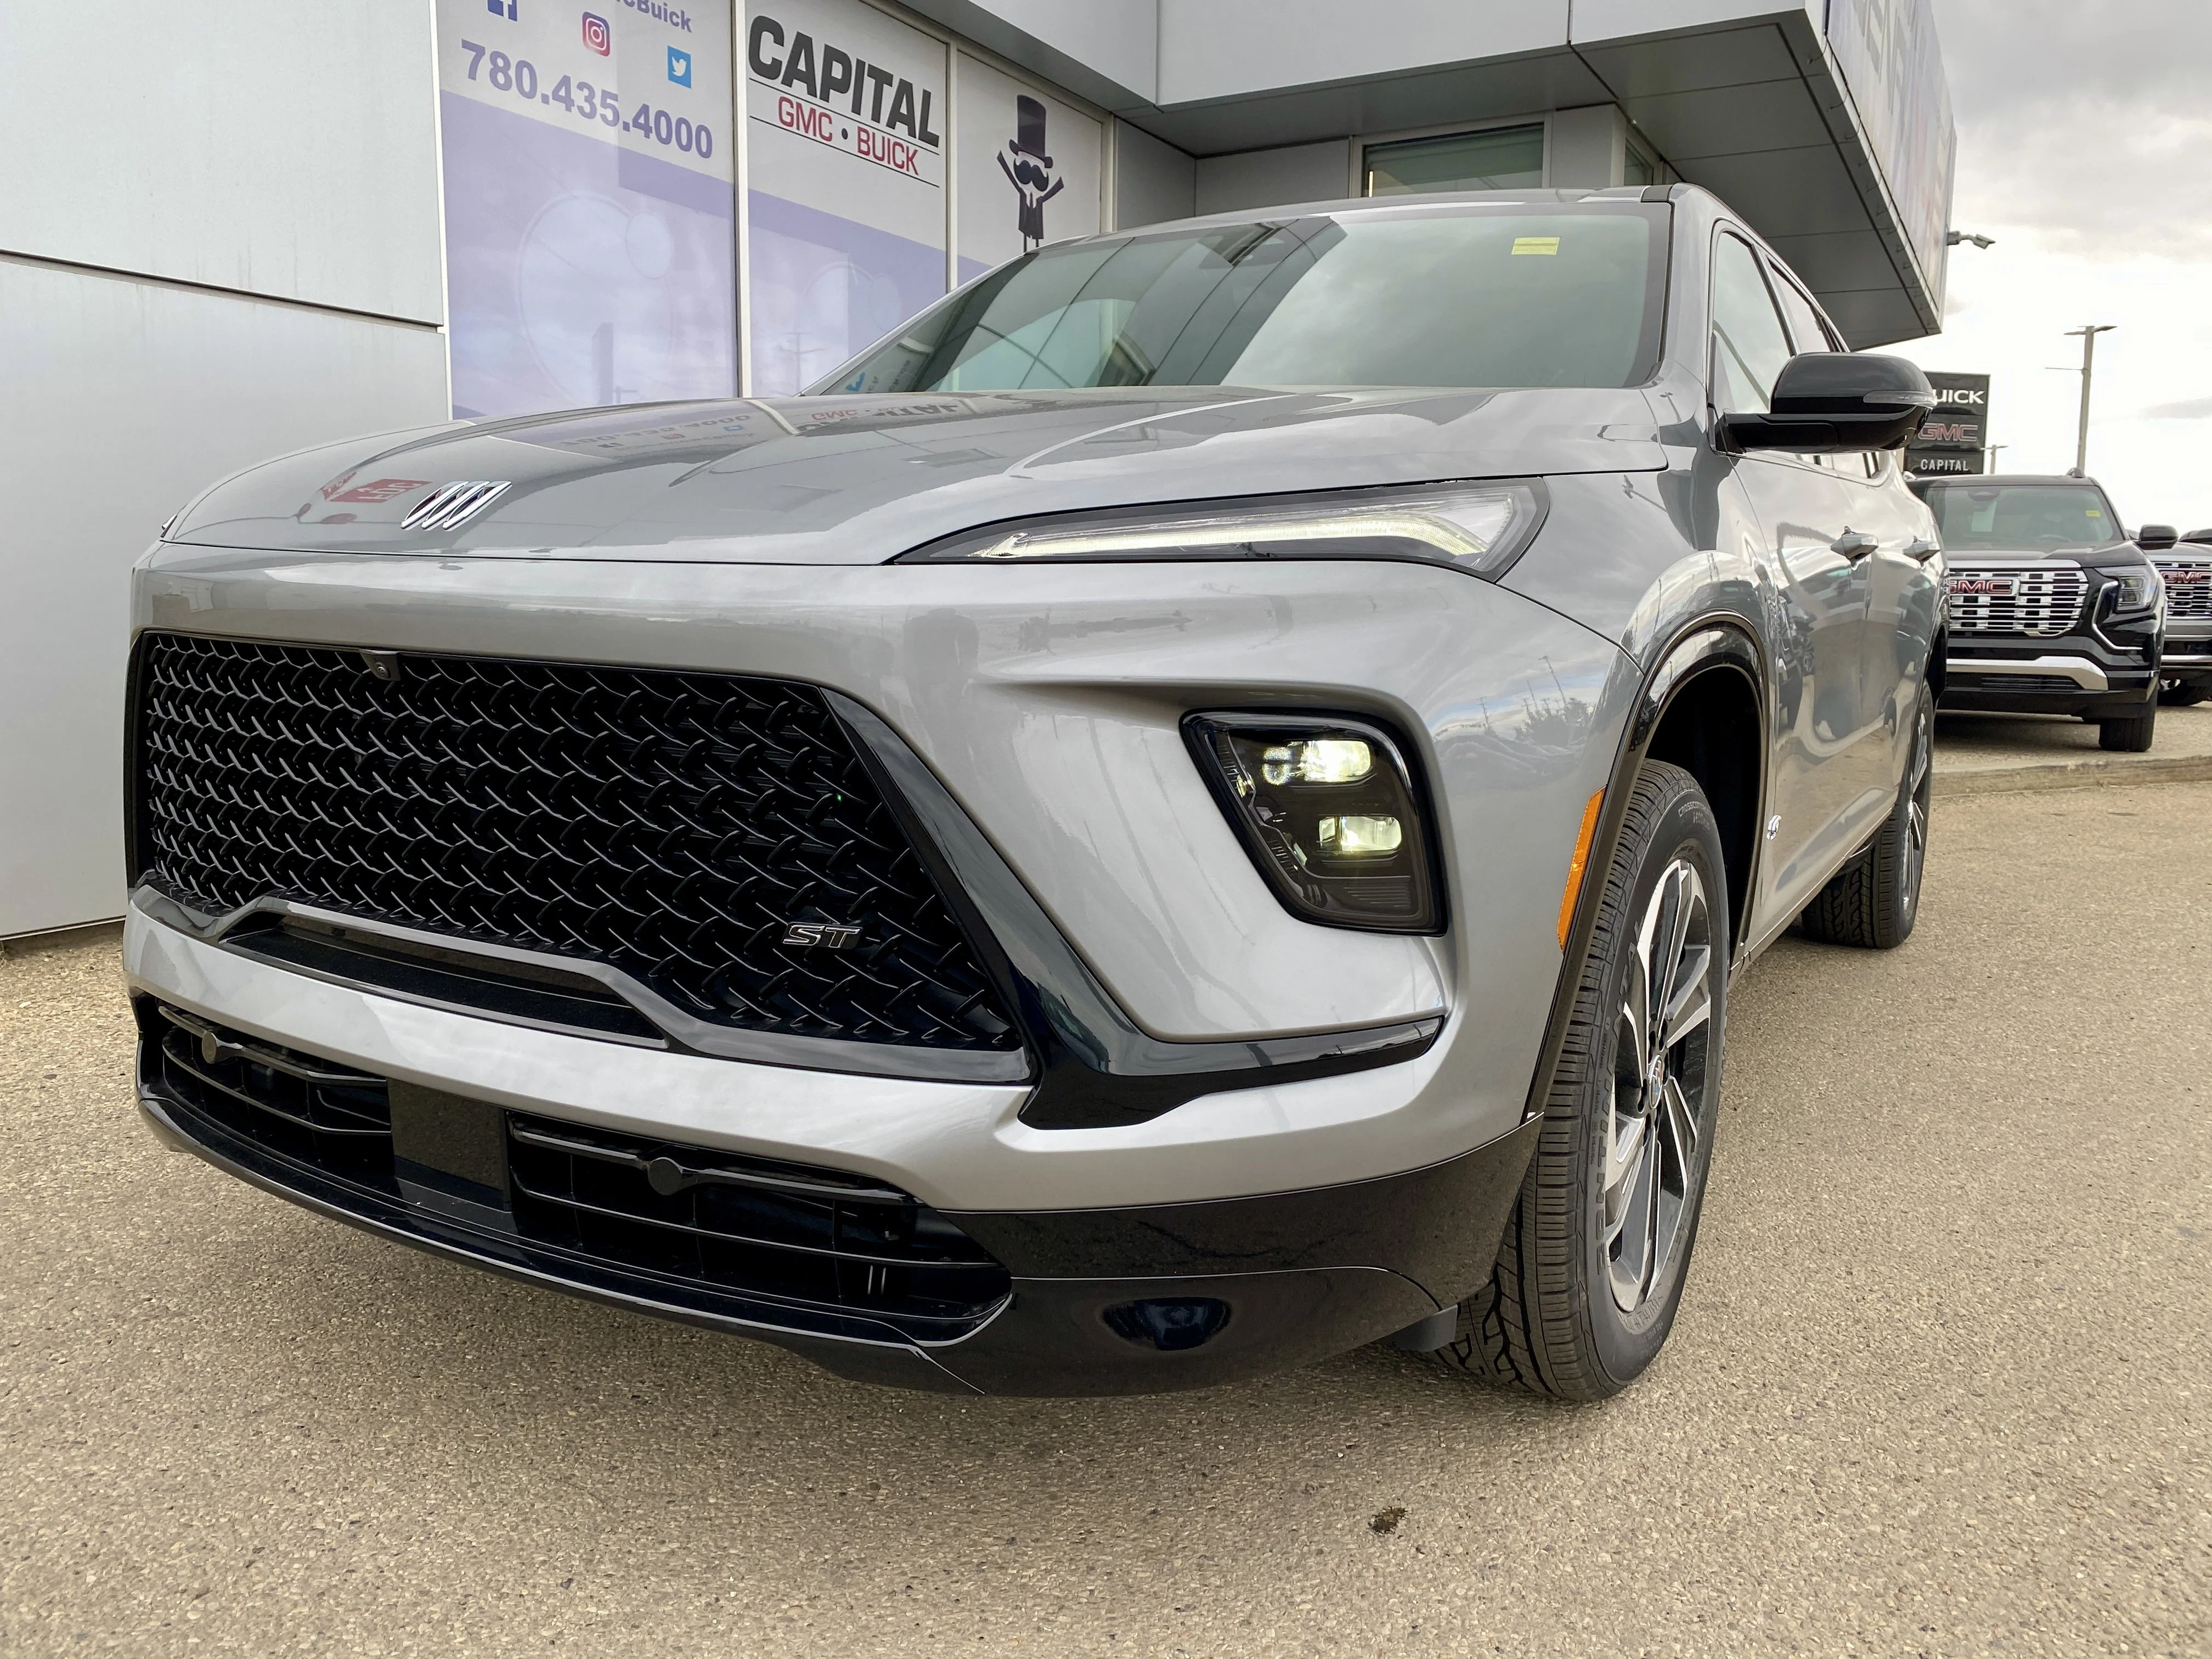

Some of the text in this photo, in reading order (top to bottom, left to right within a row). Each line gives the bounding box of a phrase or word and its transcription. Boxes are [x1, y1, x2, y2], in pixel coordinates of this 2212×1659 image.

[749, 15, 940, 148] CAPITAL
[461, 38, 712, 159] 780.435.4000
[778, 96, 919, 176] GMC BUICK
[1932, 388, 1985, 404] UICK
[1917, 422, 1978, 442] GMC
[1921, 458, 1969, 471] CAPITAL
[2160, 571, 2212, 583] GMC
[782, 924, 860, 949] ST
